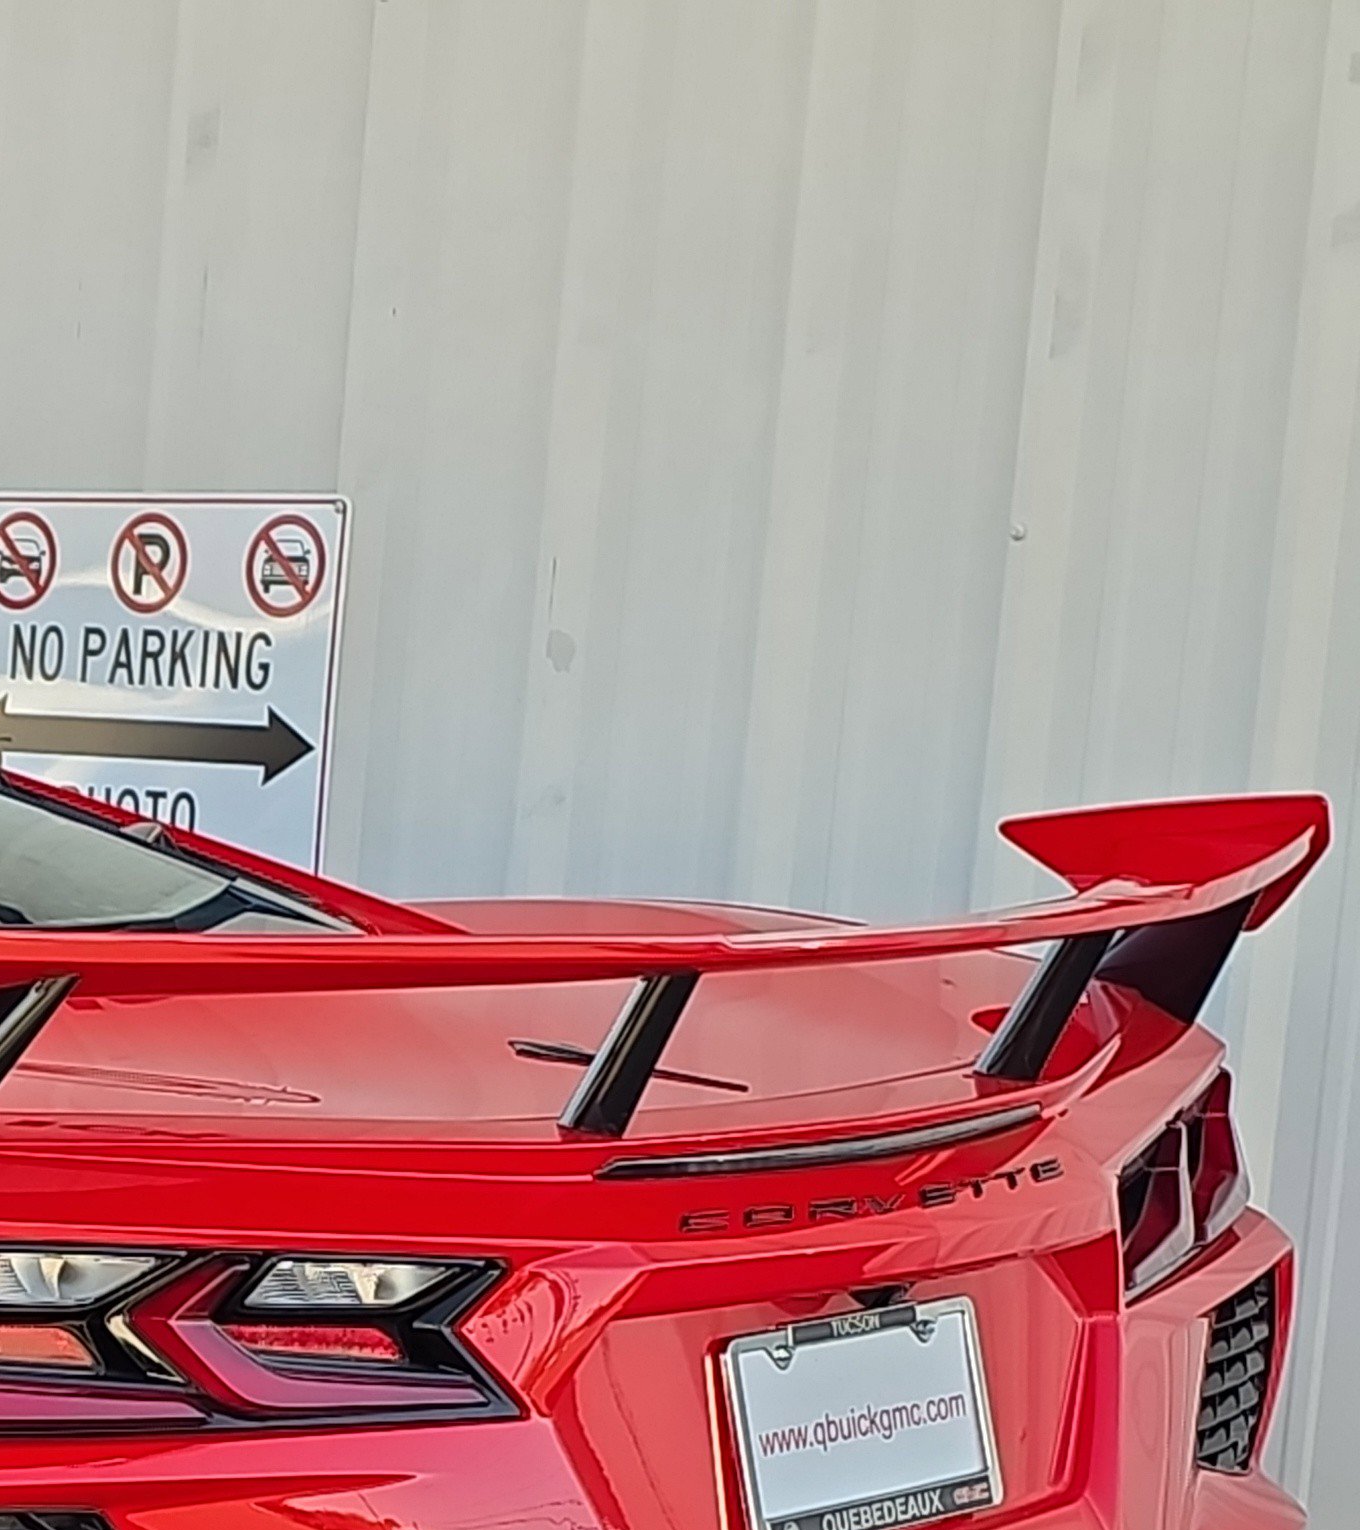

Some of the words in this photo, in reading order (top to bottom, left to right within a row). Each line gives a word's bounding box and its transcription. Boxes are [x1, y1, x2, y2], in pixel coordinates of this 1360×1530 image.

[9, 624, 65, 681] NO
[79, 626, 274, 691] PARKING
[680, 1157, 1065, 1233] CORVETTE
[830, 1313, 881, 1338] TUCSON
[759, 1392, 968, 1457] www.qbuickgmc.com
